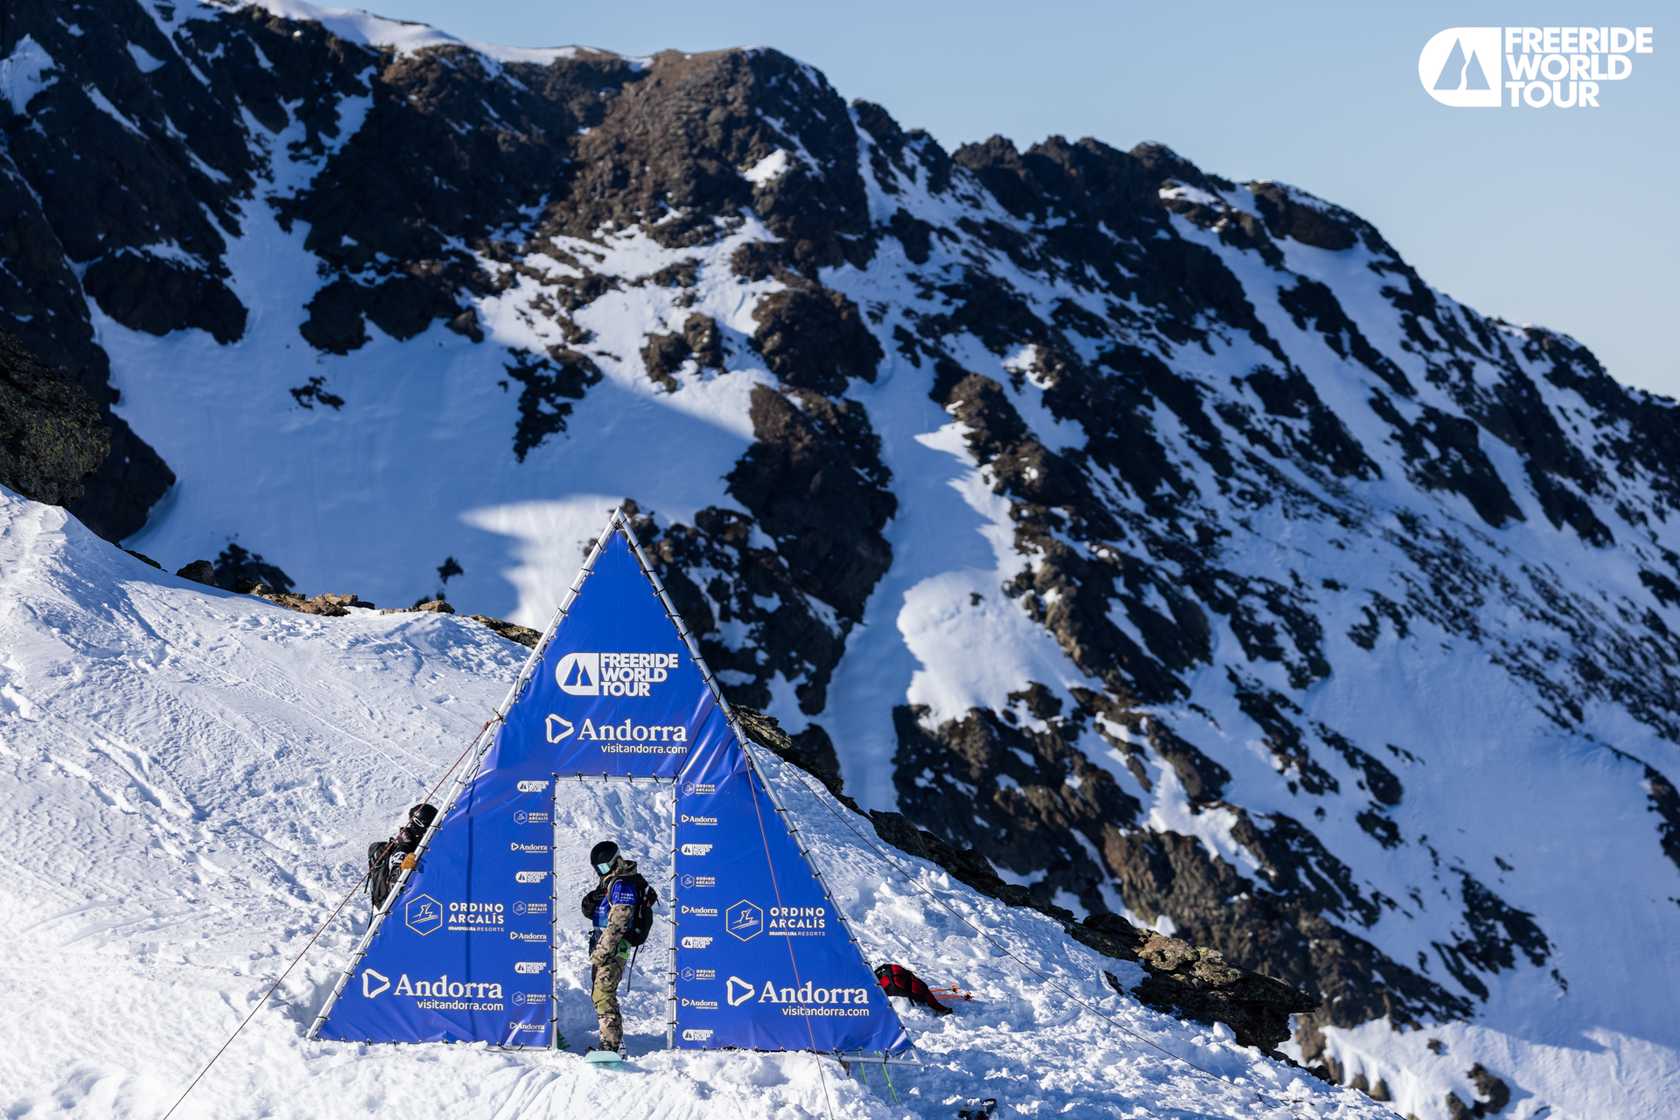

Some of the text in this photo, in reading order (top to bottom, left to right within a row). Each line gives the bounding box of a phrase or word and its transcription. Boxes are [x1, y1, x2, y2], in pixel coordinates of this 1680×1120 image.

[600, 652, 679, 668] FREERIDE
[600, 667, 668, 682] WORLD
[600, 681, 651, 697] TOUR
[577, 718, 688, 742] Andorra
[600, 743, 688, 754] visitandorra.com
[449, 902, 504, 913] ORDINO
[769, 907, 825, 917] ORDINO
[448, 912, 505, 924] ARCALÍS
[769, 916, 826, 928] ARCALÍS
[393, 973, 504, 999] Andorra
[757, 980, 870, 1004] Andorra
[417, 999, 504, 1011] visitandorra.com
[782, 1005, 870, 1017] visitandorra.com
